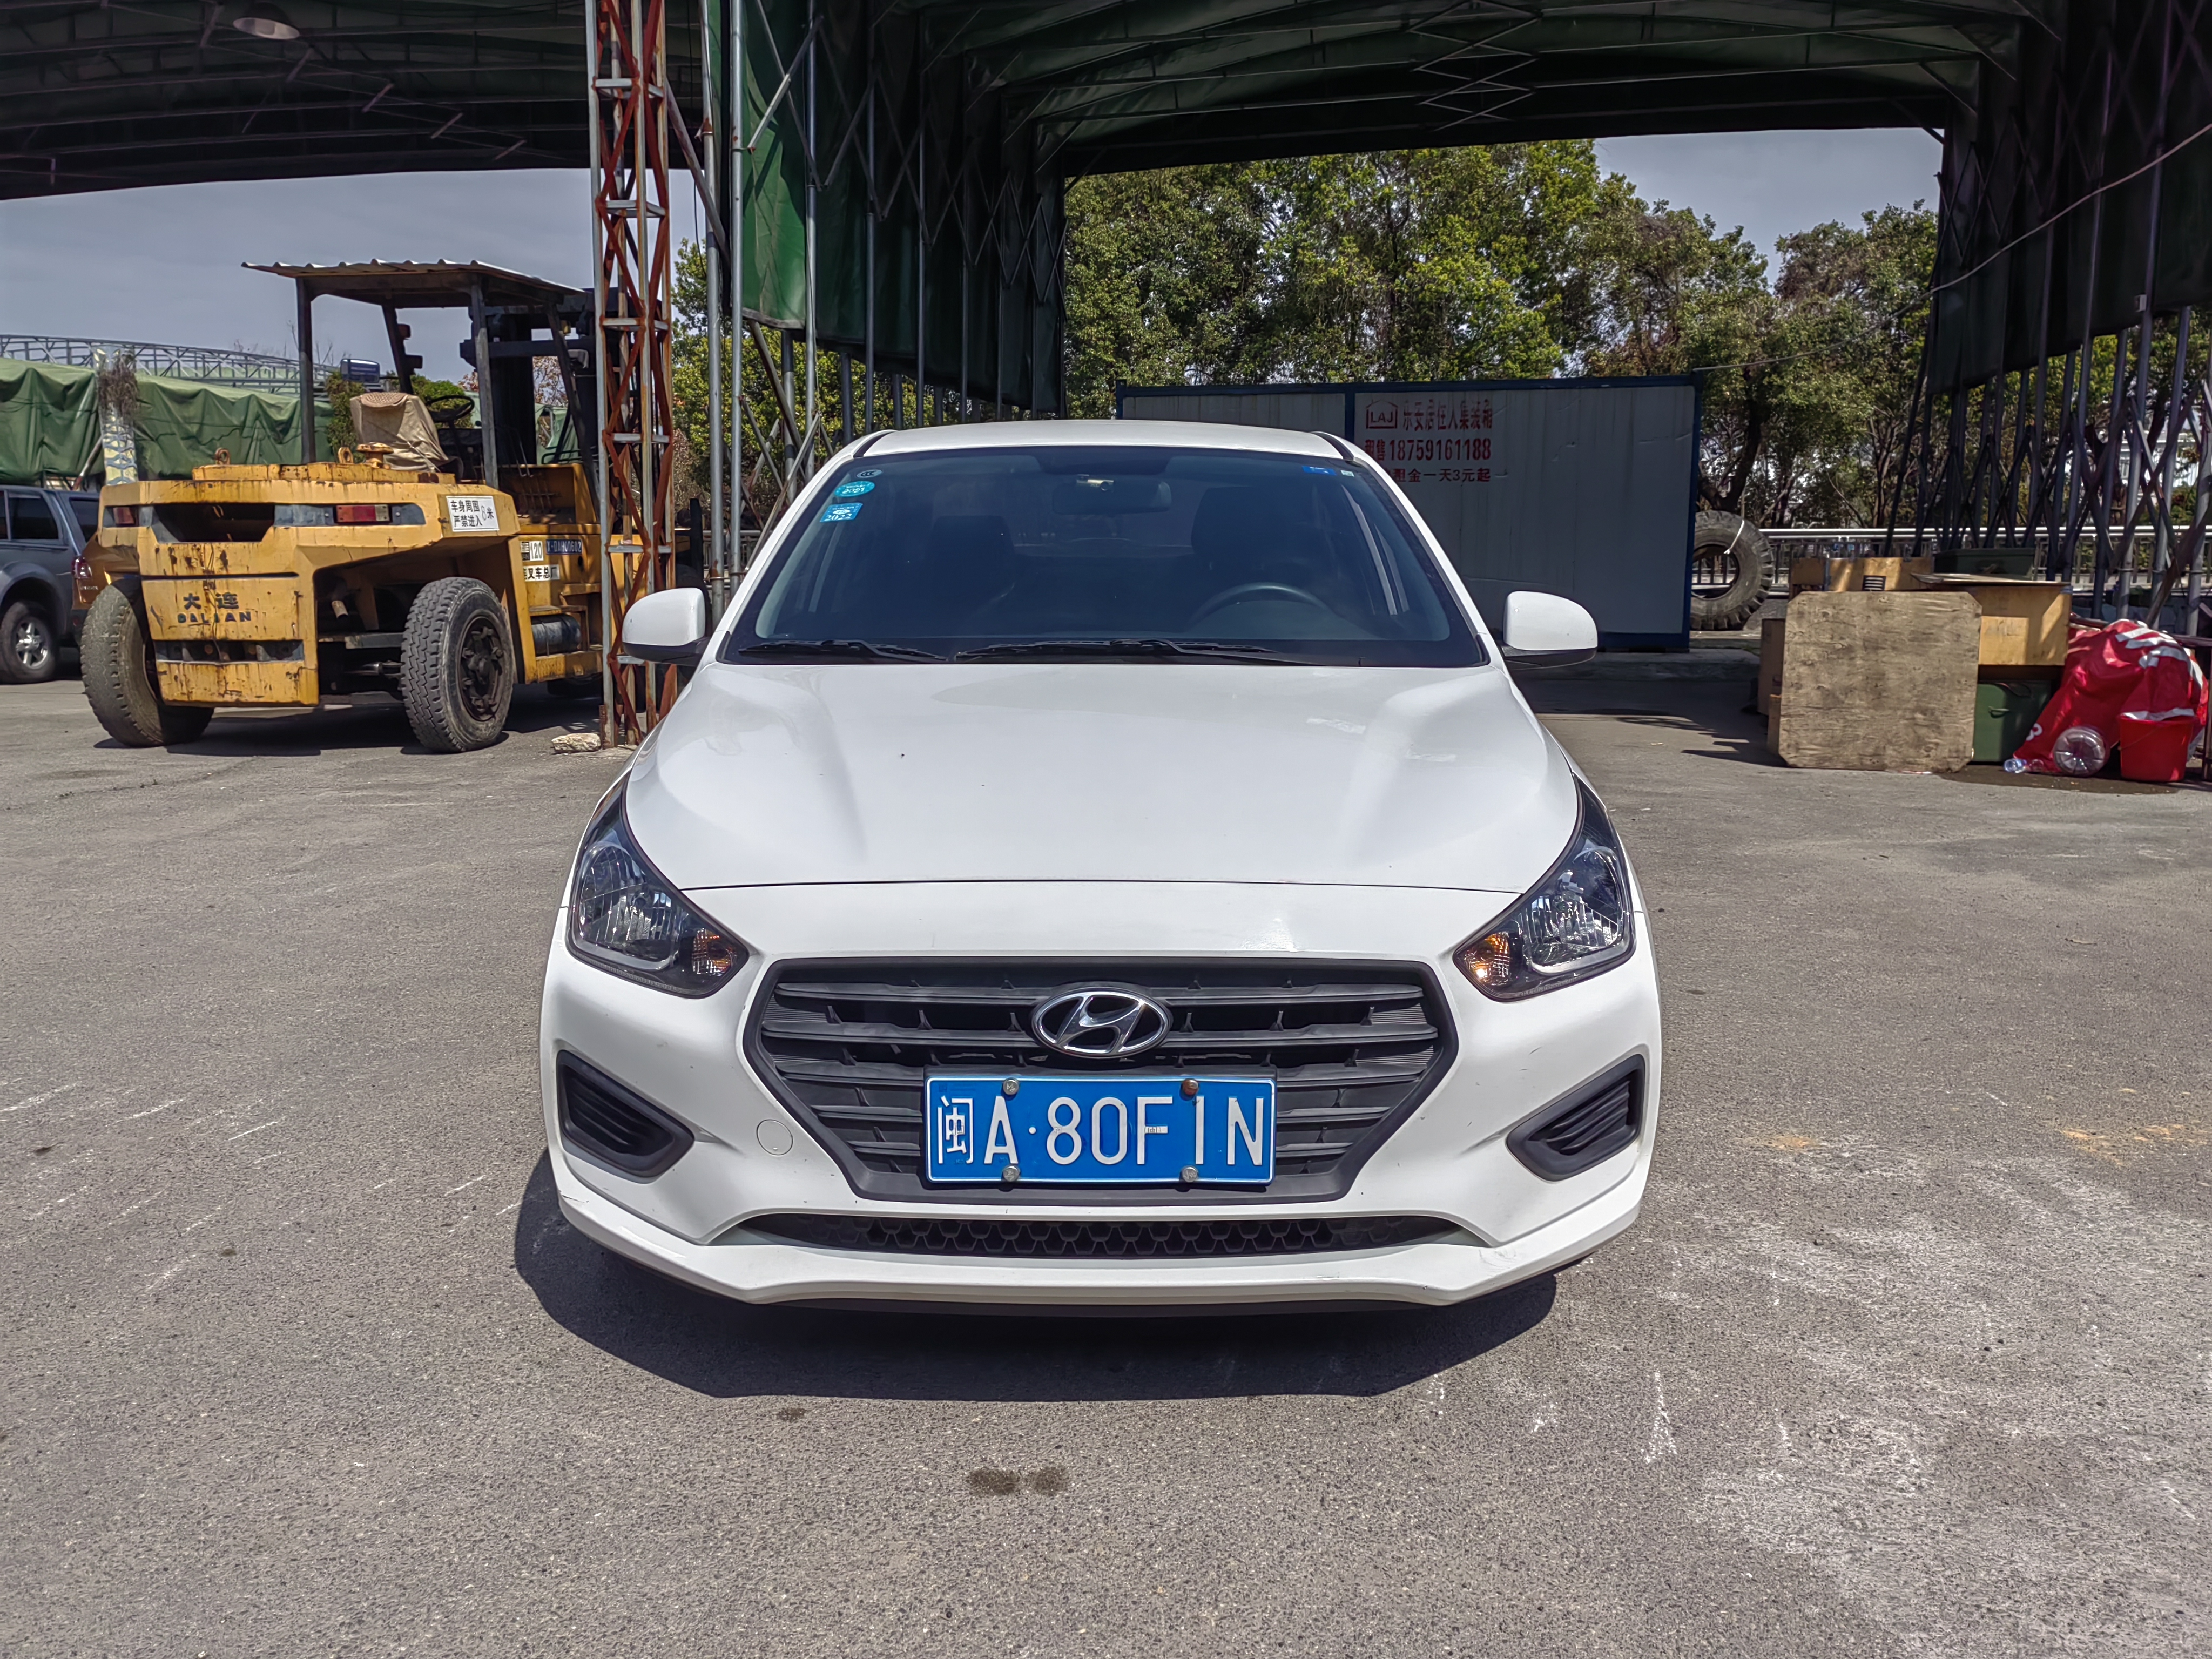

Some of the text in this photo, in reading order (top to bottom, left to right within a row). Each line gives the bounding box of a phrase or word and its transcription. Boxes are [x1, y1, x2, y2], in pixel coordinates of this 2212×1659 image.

[1371, 411, 1393, 423] LAJ
[450, 500, 480, 512] 车身周围
[454, 514, 483, 528] 严禁进入
[823, 513, 852, 521] 2022
[530, 542, 542, 559] 120
[177, 611, 251, 623] DALIAN
